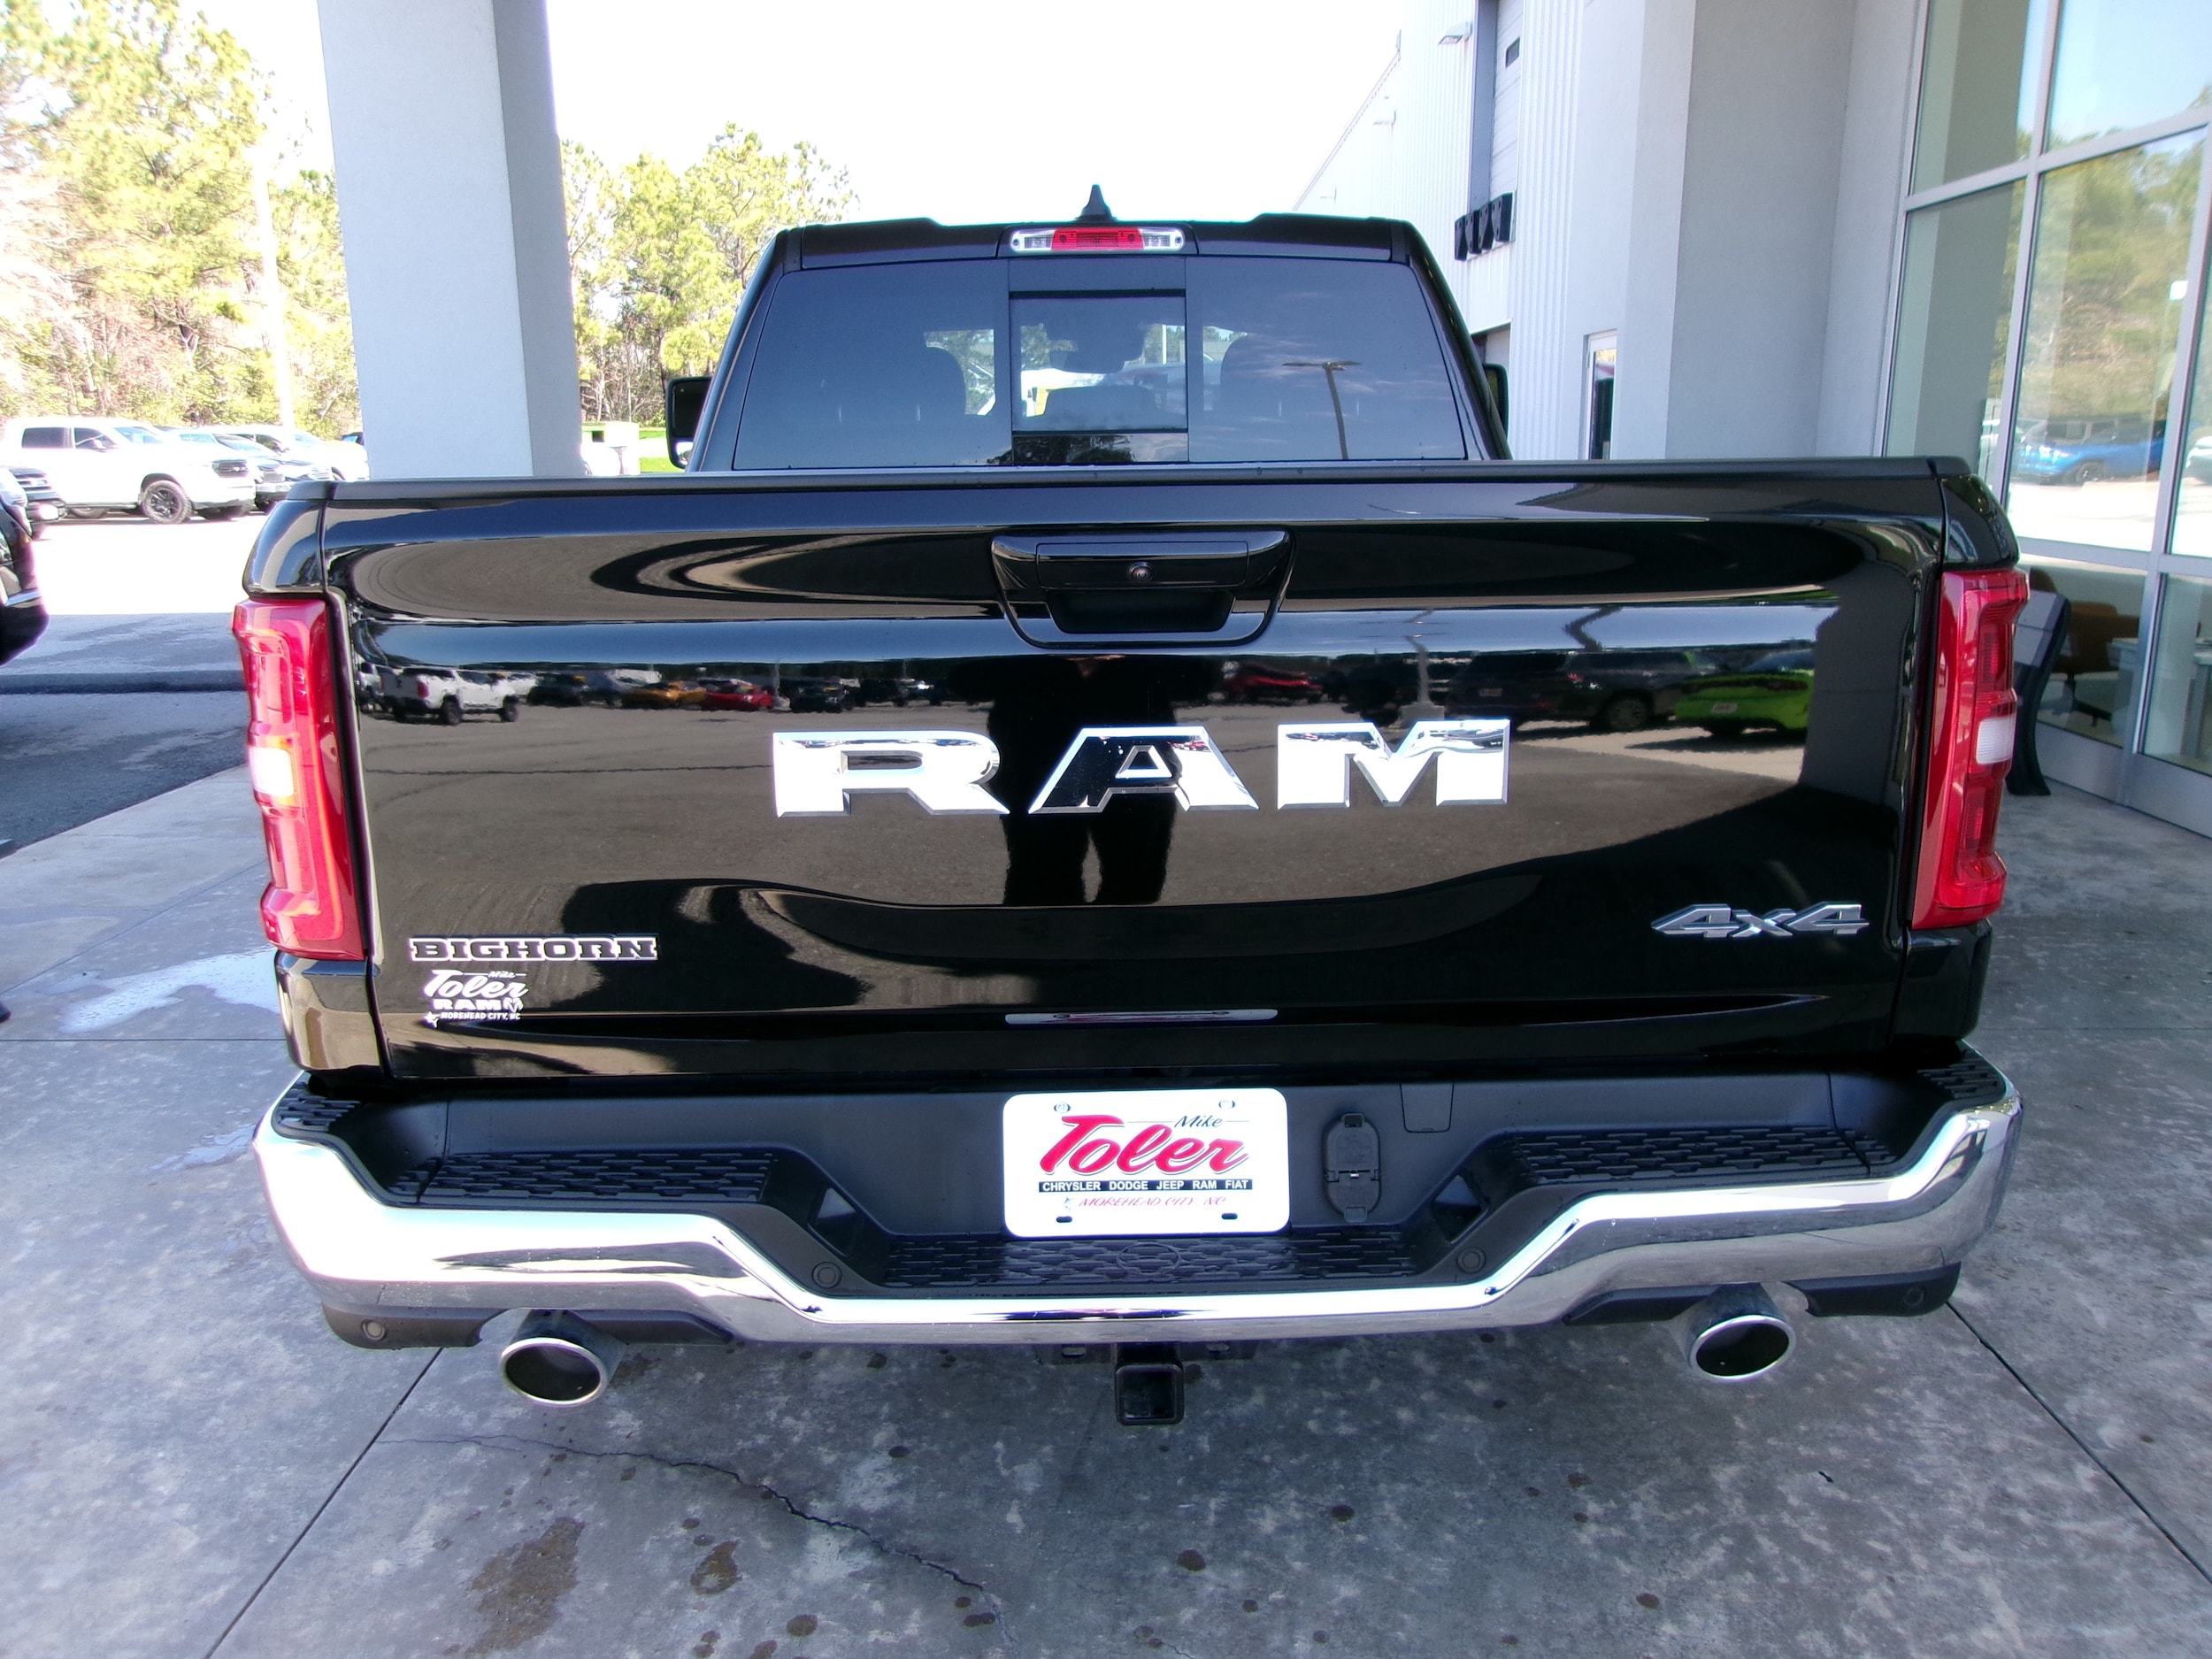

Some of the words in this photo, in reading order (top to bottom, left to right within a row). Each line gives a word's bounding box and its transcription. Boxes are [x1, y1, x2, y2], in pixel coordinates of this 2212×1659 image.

[773, 718, 1511, 818] RAM
[1650, 901, 1870, 939] 4x4
[408, 934, 658, 962] BIGHORN
[424, 969, 529, 999] Toler
[432, 998, 503, 1011] RAM
[1173, 1115, 1224, 1128] Mike
[1040, 1115, 1248, 1175] Toler
[1042, 1180, 1102, 1192] CHRYSLER
[1109, 1180, 1149, 1191] DODGE
[1156, 1179, 1185, 1191] JEEP
[1192, 1179, 1217, 1190] RAM
[1225, 1179, 1249, 1189] FIAT
[1078, 1196, 1161, 1208] MOREHEAD
